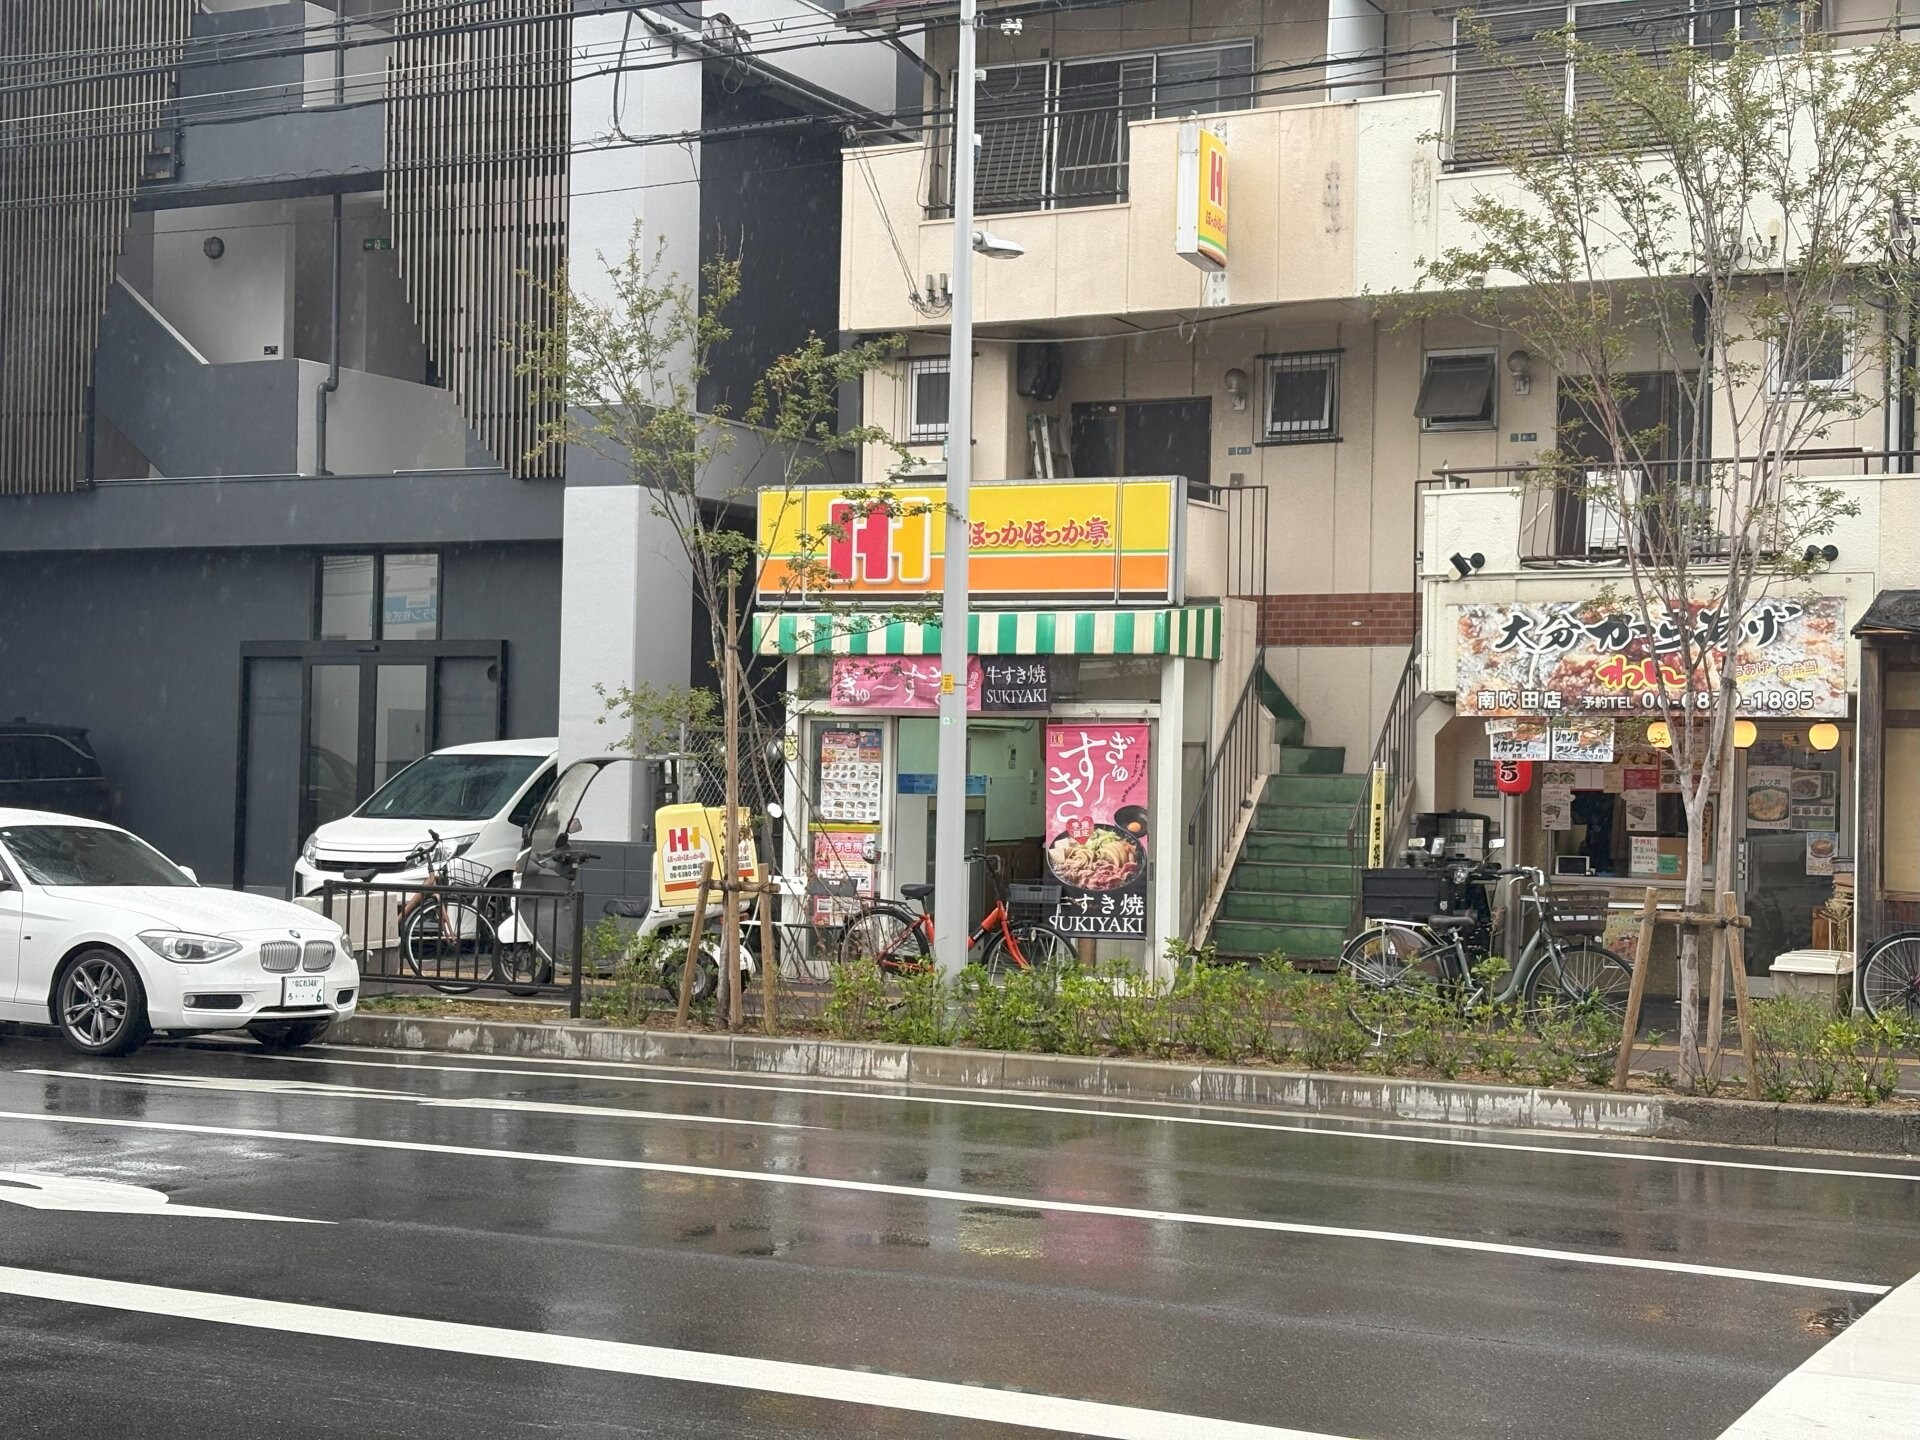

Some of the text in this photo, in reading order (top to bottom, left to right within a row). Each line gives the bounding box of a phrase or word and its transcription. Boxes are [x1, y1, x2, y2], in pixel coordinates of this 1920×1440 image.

[967, 515, 1109, 547] ほっかほっか亭
[986, 664, 1047, 685] 牛すき焼
[986, 688, 1048, 704] SUKIYAKI
[1477, 690, 1562, 710] 南吹田店
[1582, 695, 1635, 710] 予約TEL
[1493, 741, 1530, 753] イカフライ
[1049, 915, 1144, 933] SUKIYAKI
